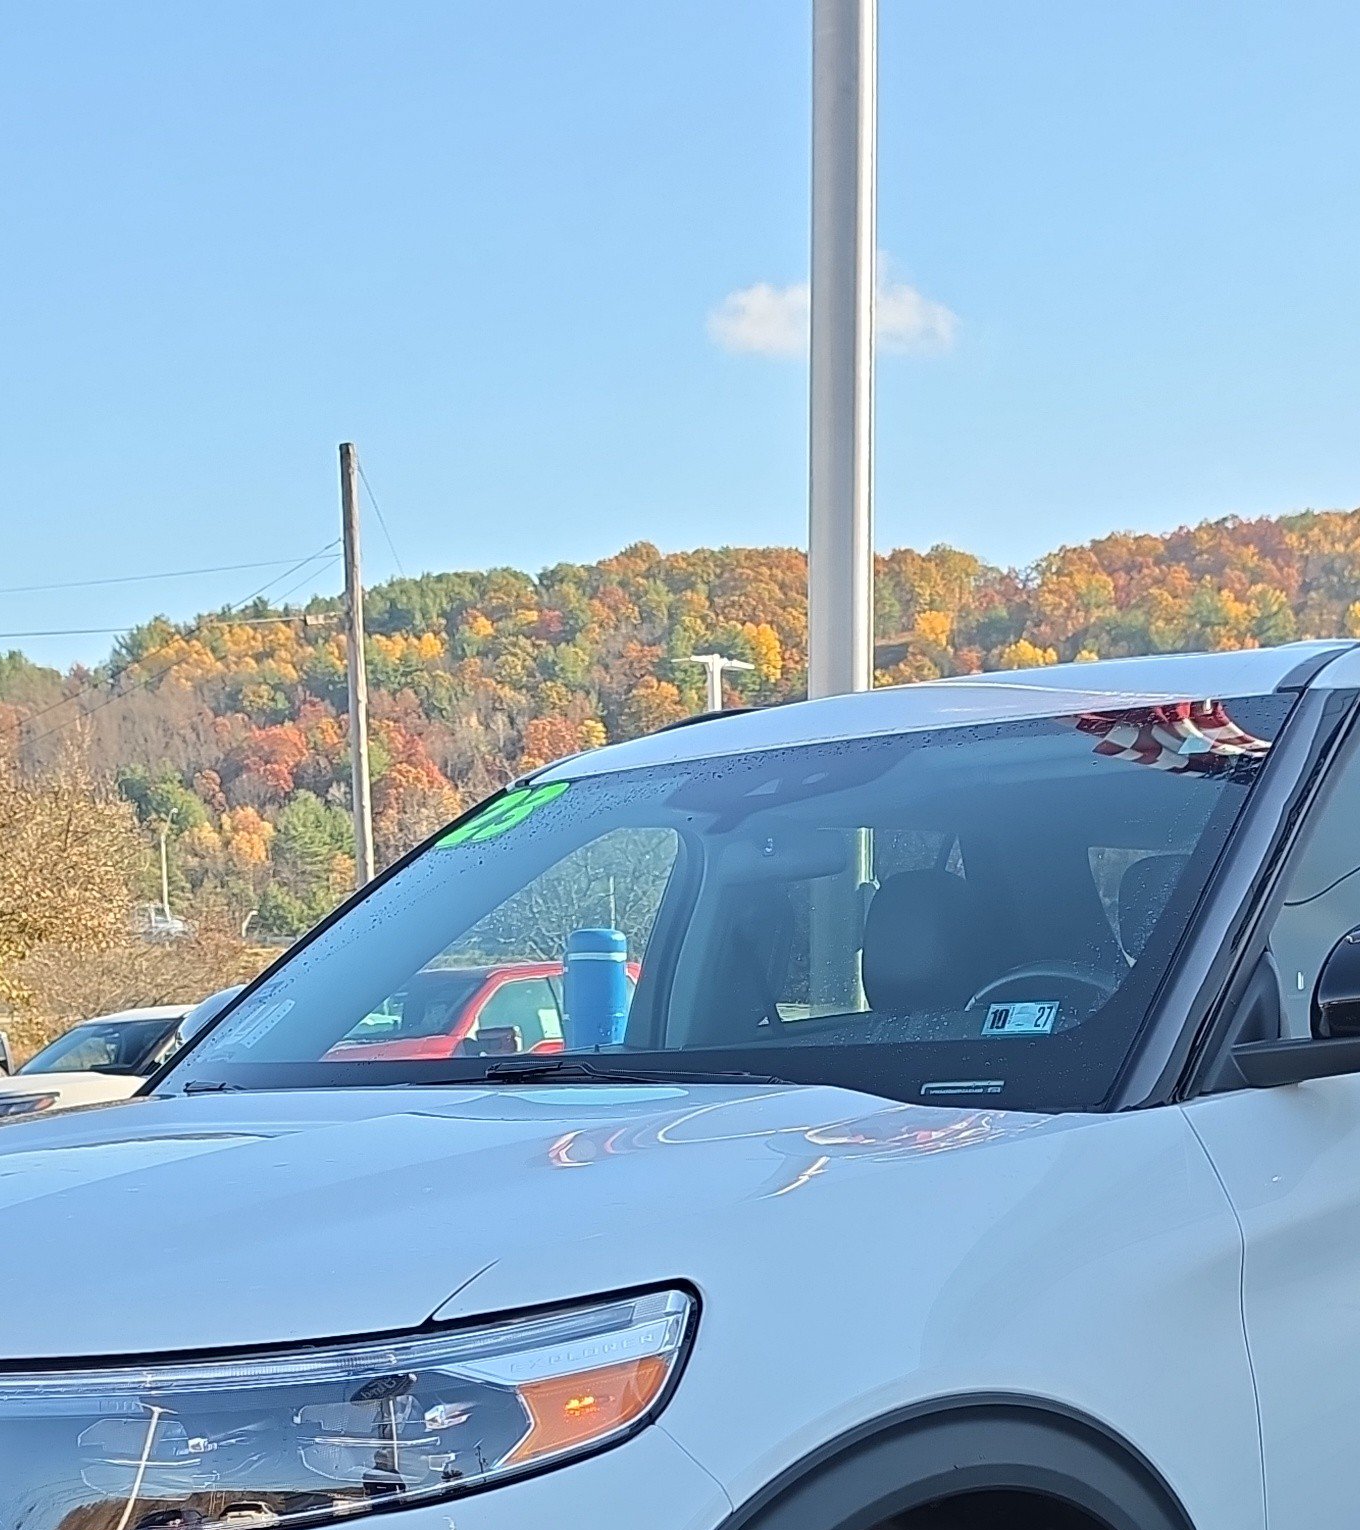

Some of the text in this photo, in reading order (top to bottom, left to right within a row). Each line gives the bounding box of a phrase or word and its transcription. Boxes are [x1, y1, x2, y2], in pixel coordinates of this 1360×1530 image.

[990, 1008, 1010, 1030] 10
[1034, 1006, 1054, 1028] 27
[510, 1334, 655, 1373] EXPLORER
